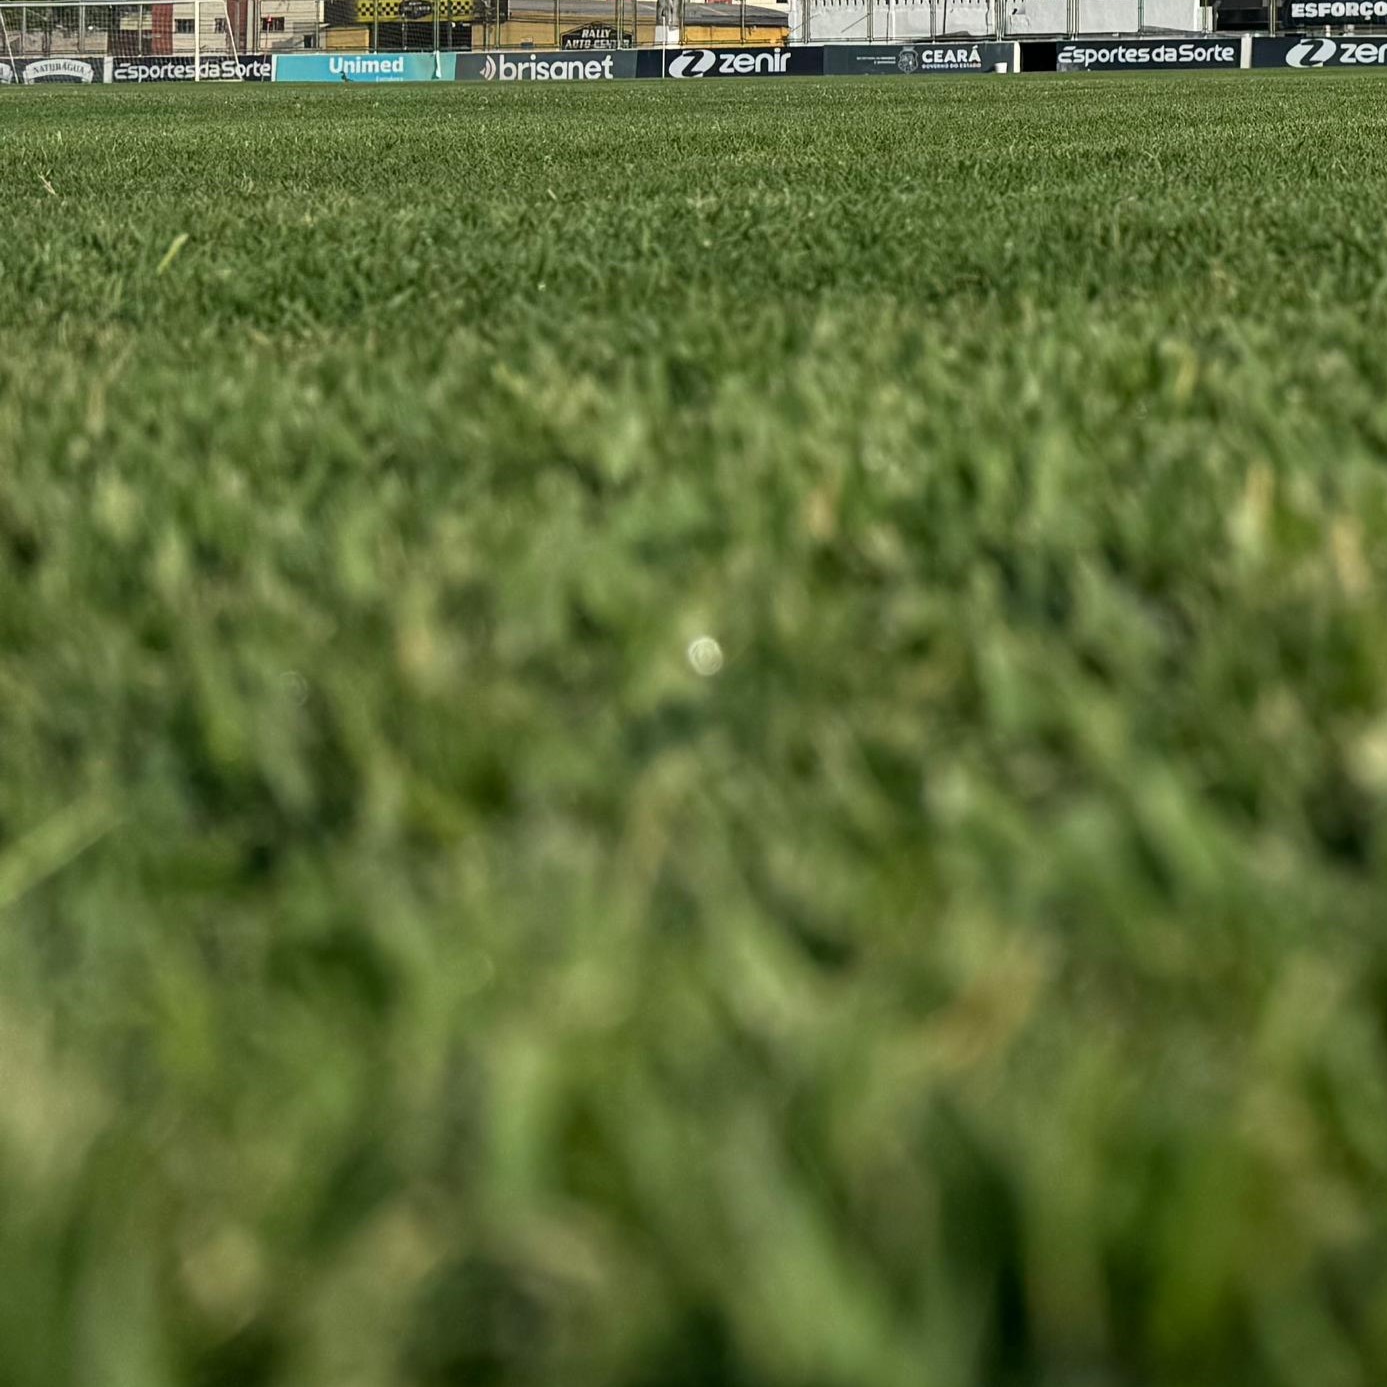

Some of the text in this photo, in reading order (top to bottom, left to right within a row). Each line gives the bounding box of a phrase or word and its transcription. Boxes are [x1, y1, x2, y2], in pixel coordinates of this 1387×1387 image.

[582, 29, 611, 38] RALLY
[565, 39, 630, 49] AUTO CENTR
[718, 48, 792, 74] zenir
[921, 45, 981, 63] CEARÁ
[1057, 44, 1150, 67] Esportes
[1179, 43, 1234, 63] Sorte
[329, 56, 404, 74] Unimed
[500, 54, 614, 80] brisanet
